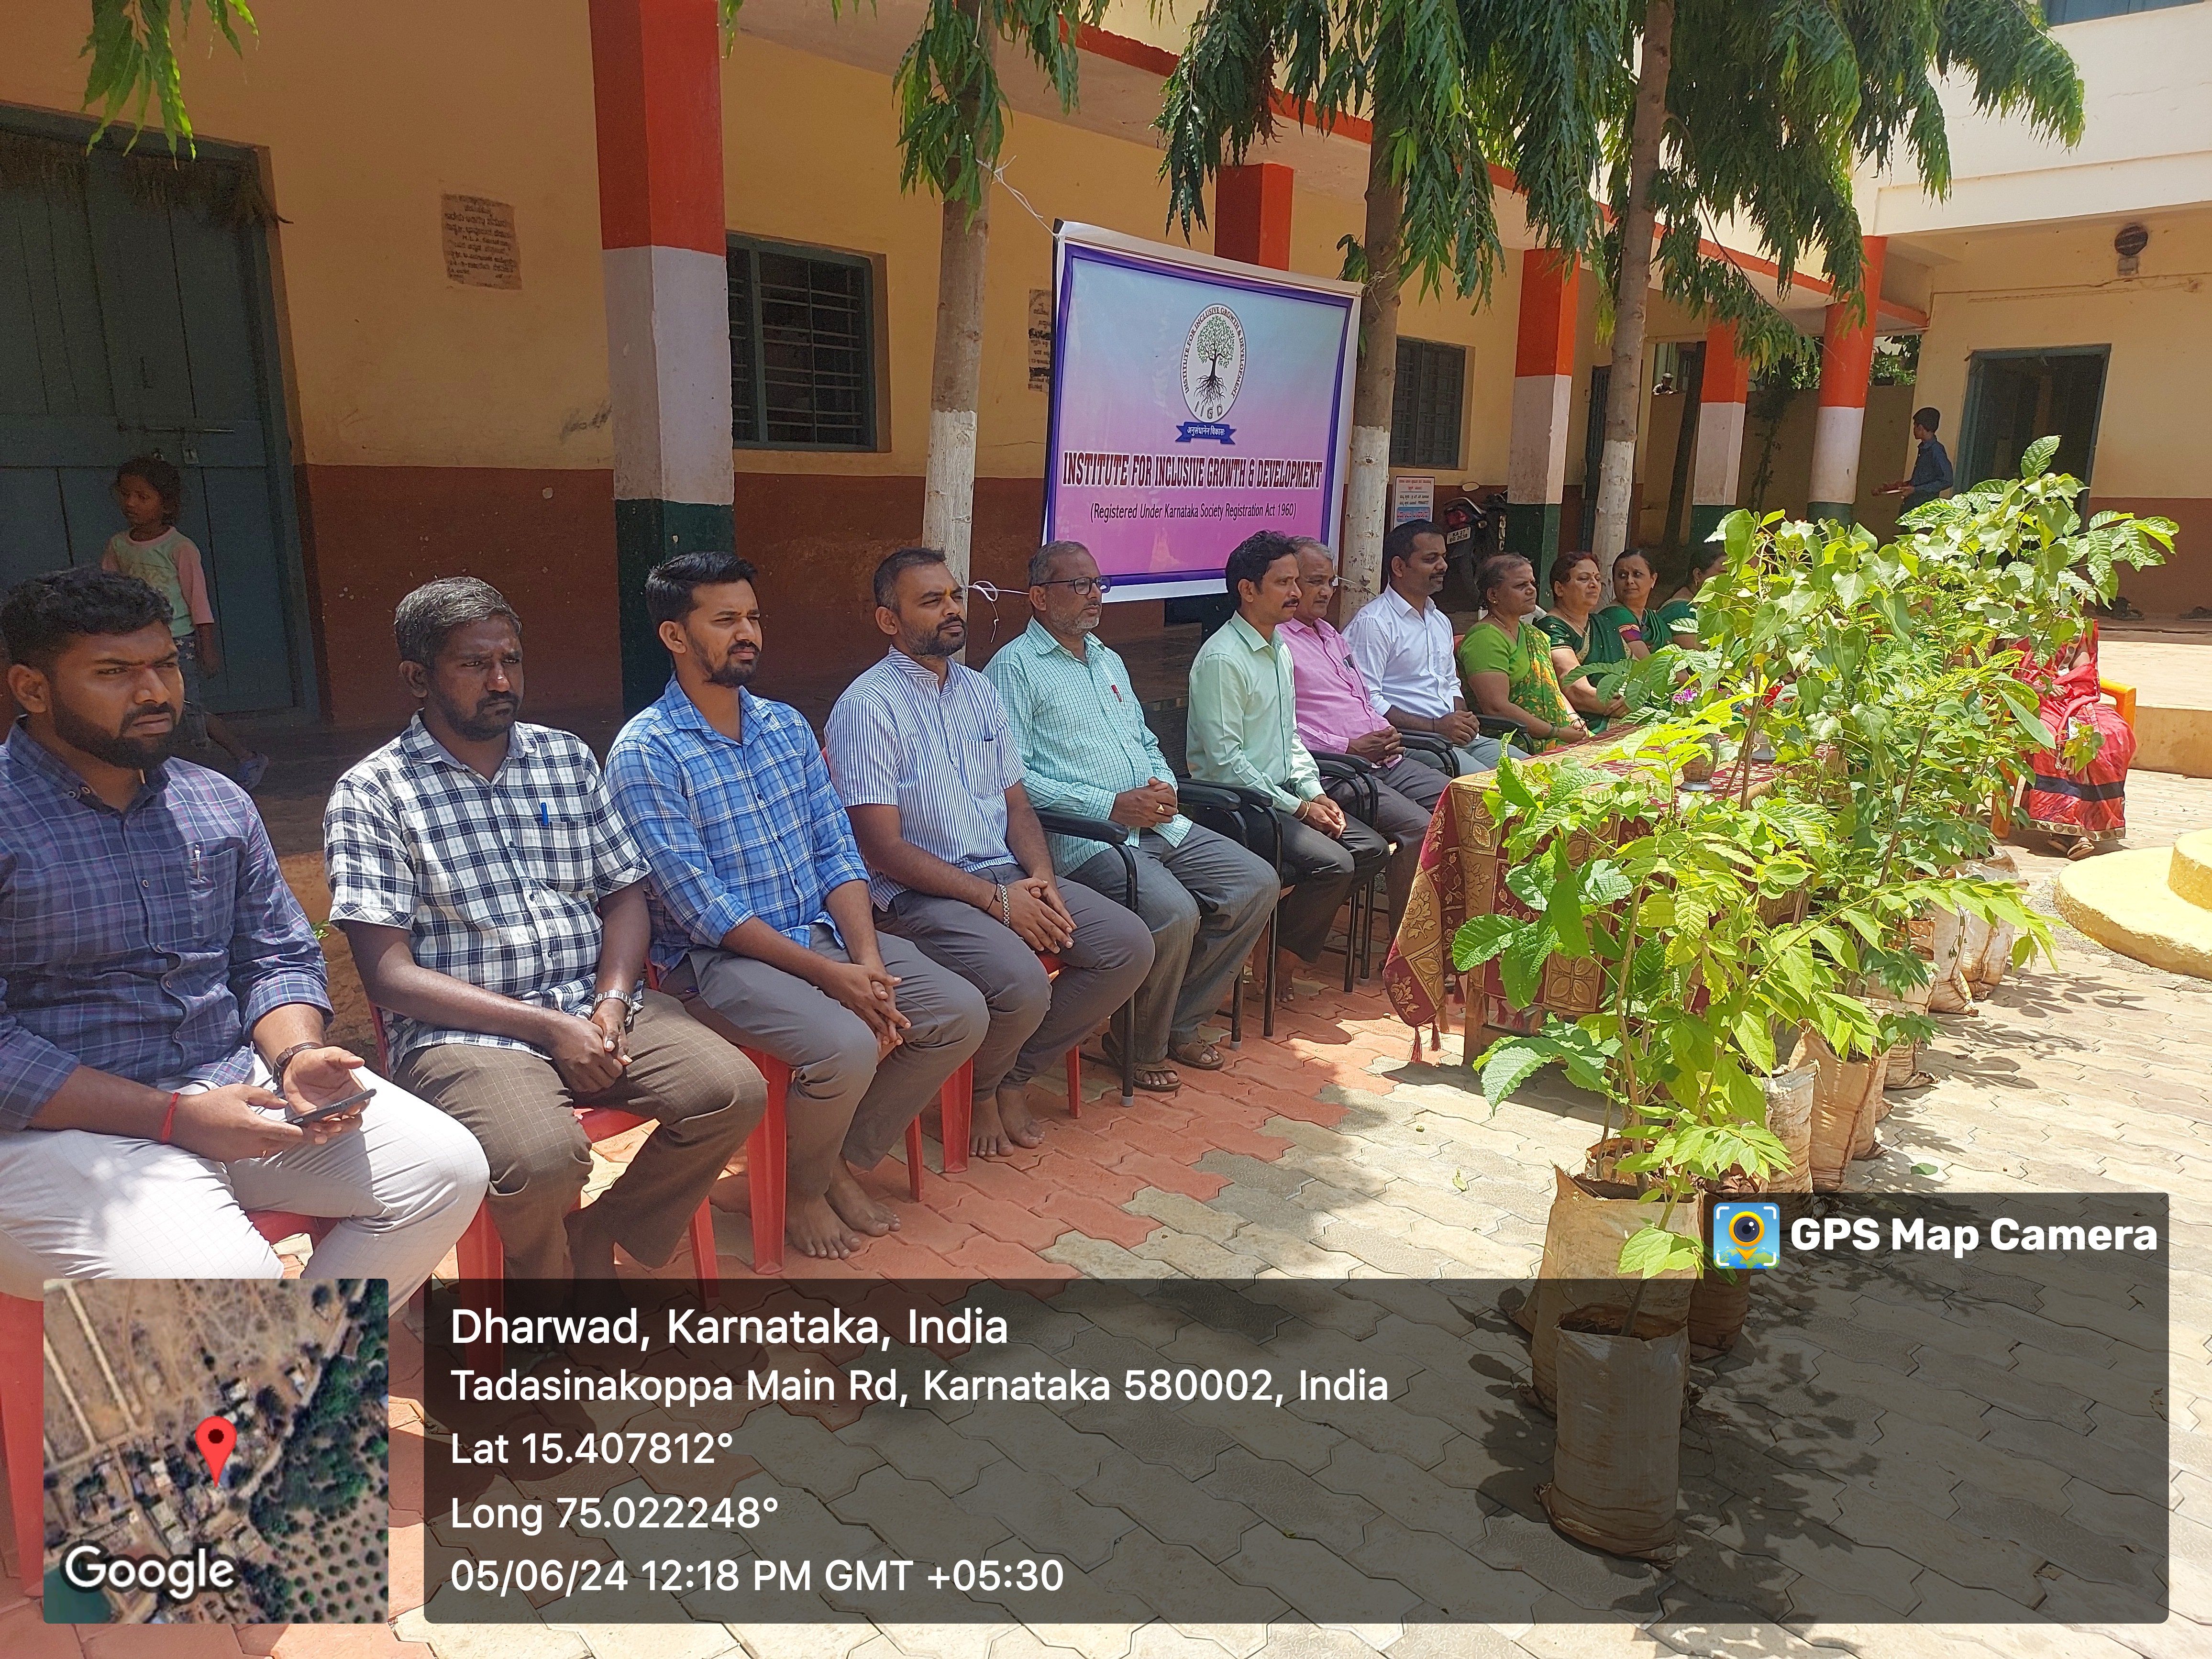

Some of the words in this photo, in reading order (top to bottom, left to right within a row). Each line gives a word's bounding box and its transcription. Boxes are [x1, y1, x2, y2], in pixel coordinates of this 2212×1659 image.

[1187, 329, 1196, 347] FOR
[1194, 307, 1219, 330] INCLUSIVE
[1220, 308, 1240, 330] GROWTH
[1231, 336, 1245, 399] DEVELOPMENT
[1187, 425, 1210, 436] अनुसंधानेन
[1063, 452, 1130, 486] INSTITUTE
[1131, 455, 1152, 487] FOR
[1154, 456, 1205, 487] INCLUSIVE
[1206, 457, 1247, 487] GROWTH
[1248, 459, 1255, 487] &
[1256, 460, 1323, 488] DEVELOPMENT
[1090, 503, 1138, 523] (Registered
[1140, 504, 1162, 519] Under
[1164, 503, 1198, 518] Karnataka
[1200, 503, 1224, 521] Society
[1225, 503, 1263, 521] Registration
[1265, 503, 1276, 517] Act
[1278, 503, 1296, 520] 1960)
